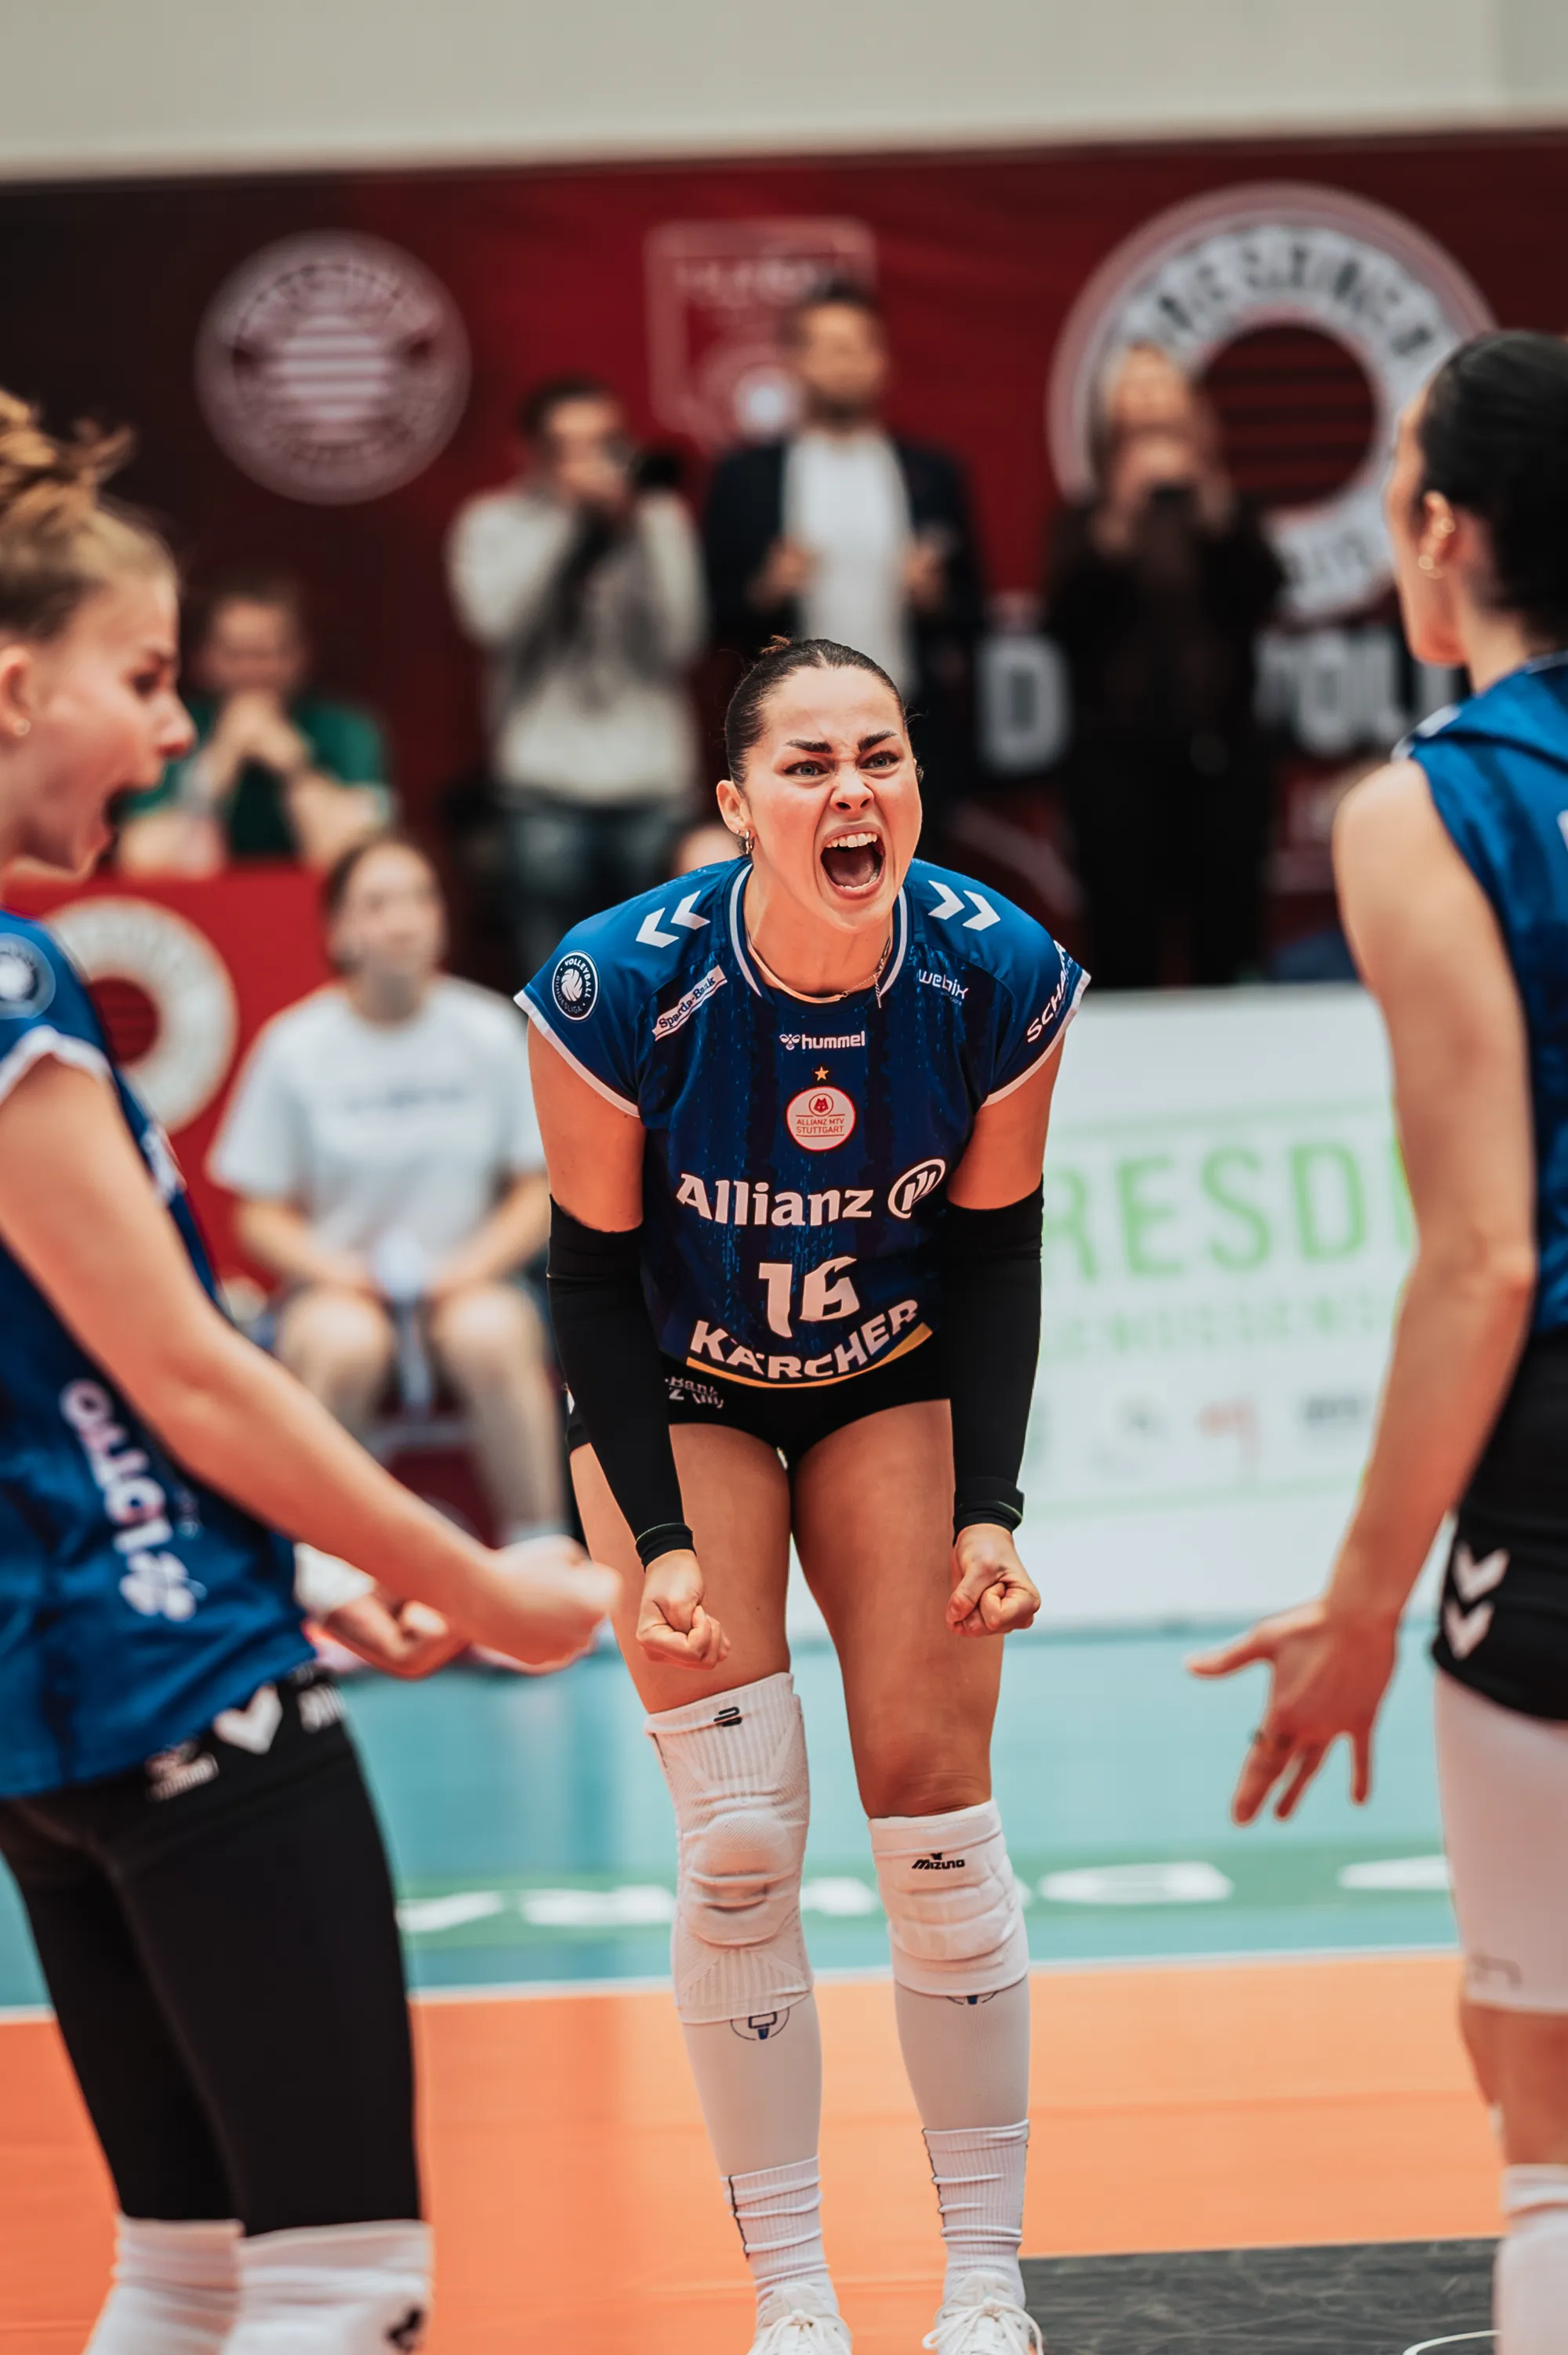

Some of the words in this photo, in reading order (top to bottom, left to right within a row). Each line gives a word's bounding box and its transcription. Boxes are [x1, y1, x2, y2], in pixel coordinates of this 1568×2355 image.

[554, 975, 583, 1014] BUNDESLIGA
[564, 958, 592, 998] VOLLEYBALL
[658, 976, 716, 1030] Sparda-Bank
[801, 1030, 866, 1050] hummel
[796, 1125, 844, 1134] STUTTGART
[797, 1118, 827, 1126] ALLIANZ
[676, 1173, 874, 1227] Allianz
[757, 1256, 858, 1339] 16
[690, 1299, 919, 1379] KÄRCHER
